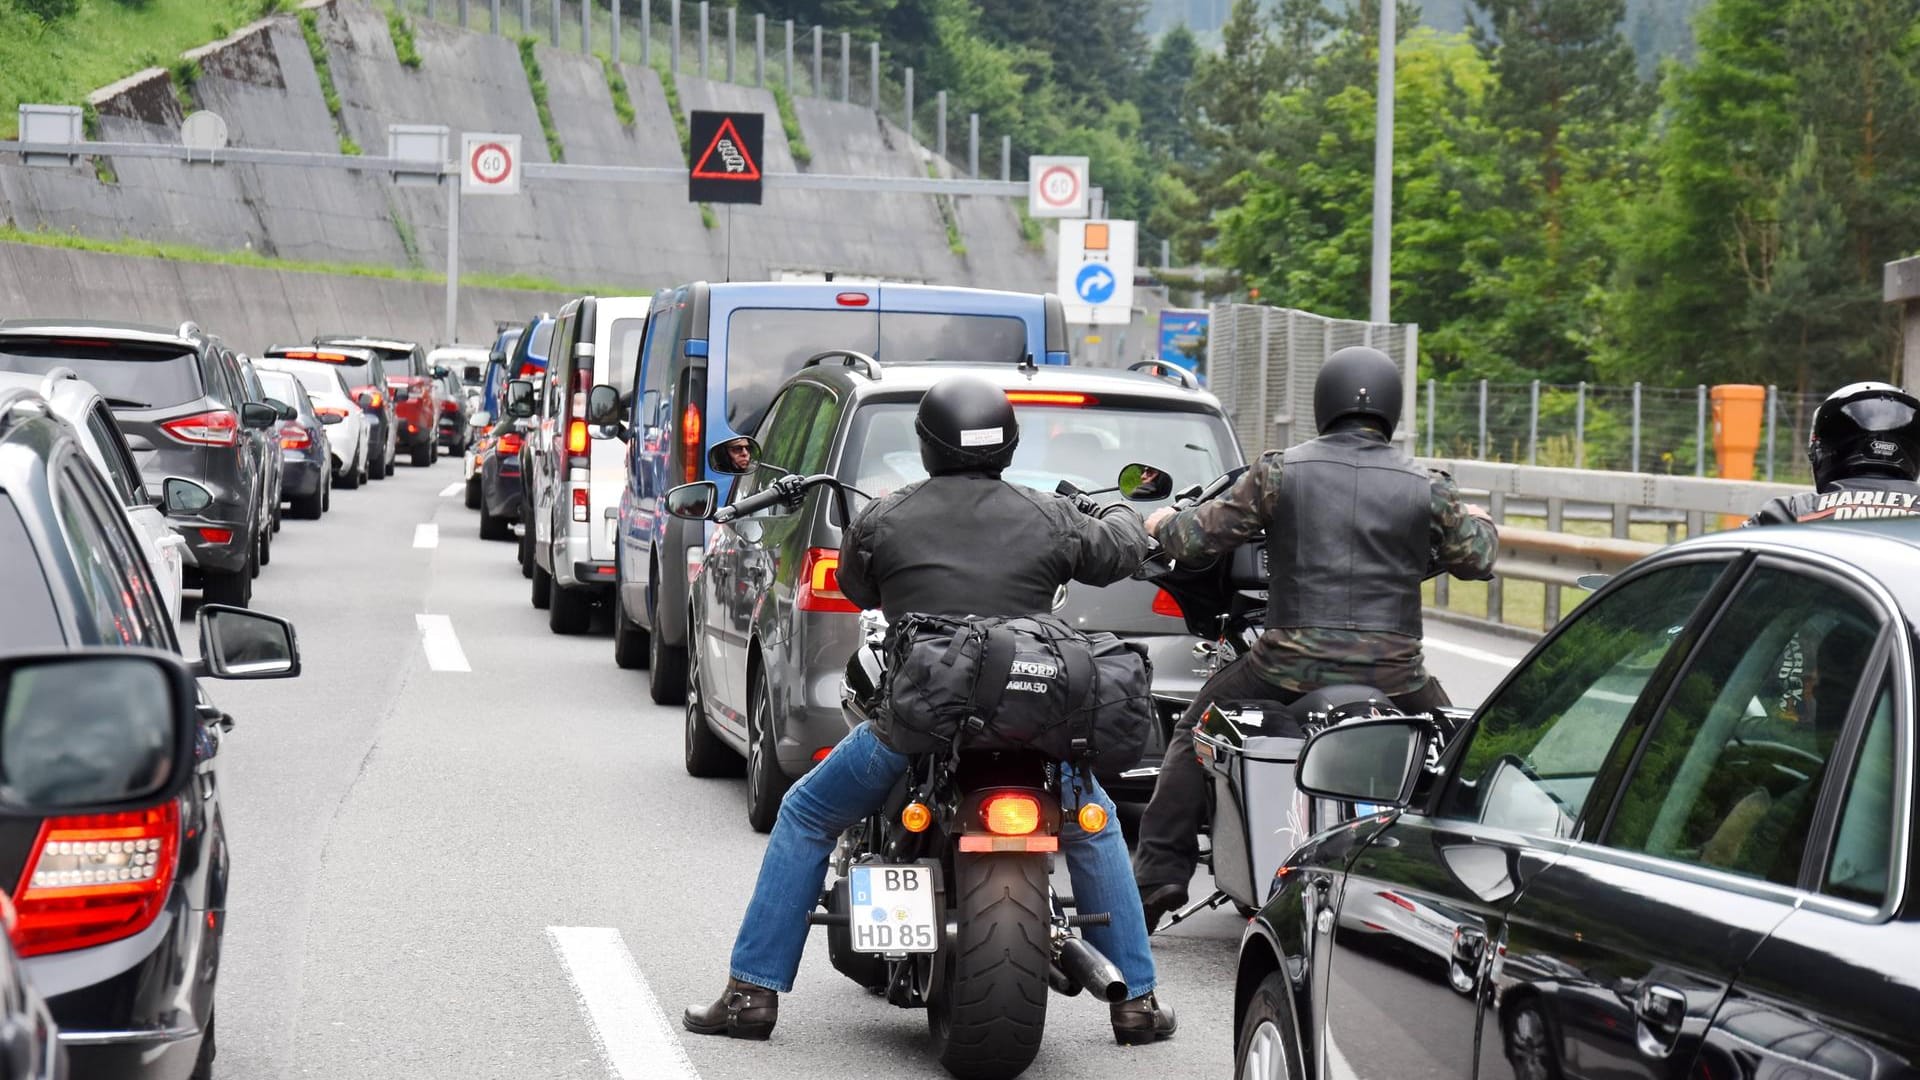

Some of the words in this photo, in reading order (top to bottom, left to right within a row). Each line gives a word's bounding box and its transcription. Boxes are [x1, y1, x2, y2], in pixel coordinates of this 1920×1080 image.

[483, 157, 501, 171] 60
[1051, 180, 1069, 194] 60
[1874, 442, 1895, 451] SHOEI
[1011, 662, 1055, 677] XFORD
[884, 869, 919, 892] BB
[858, 891, 866, 901] D
[857, 924, 893, 947] HD
[899, 924, 931, 947] 85
